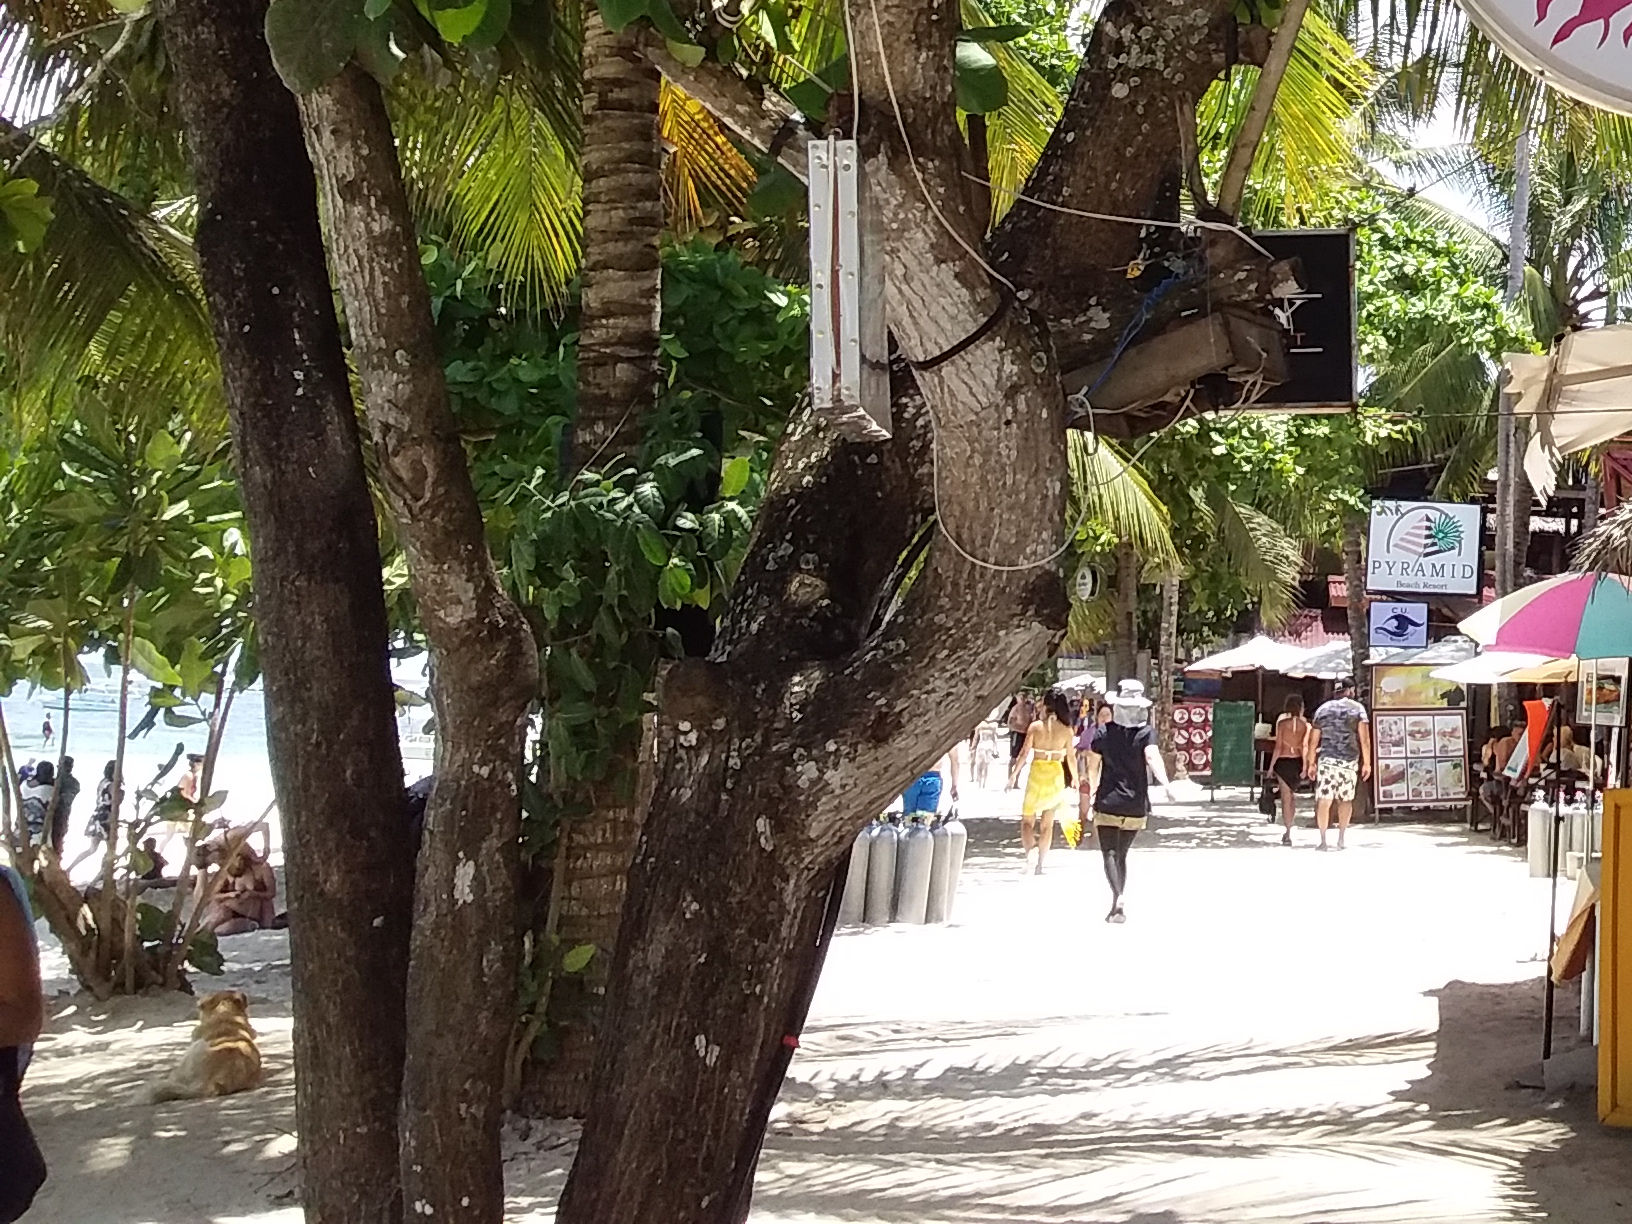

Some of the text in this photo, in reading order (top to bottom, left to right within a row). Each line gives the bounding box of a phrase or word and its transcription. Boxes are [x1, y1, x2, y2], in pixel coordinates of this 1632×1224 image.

[1371, 560, 1475, 579] PYRAMID
[1397, 581, 1448, 591] Beach Resort
